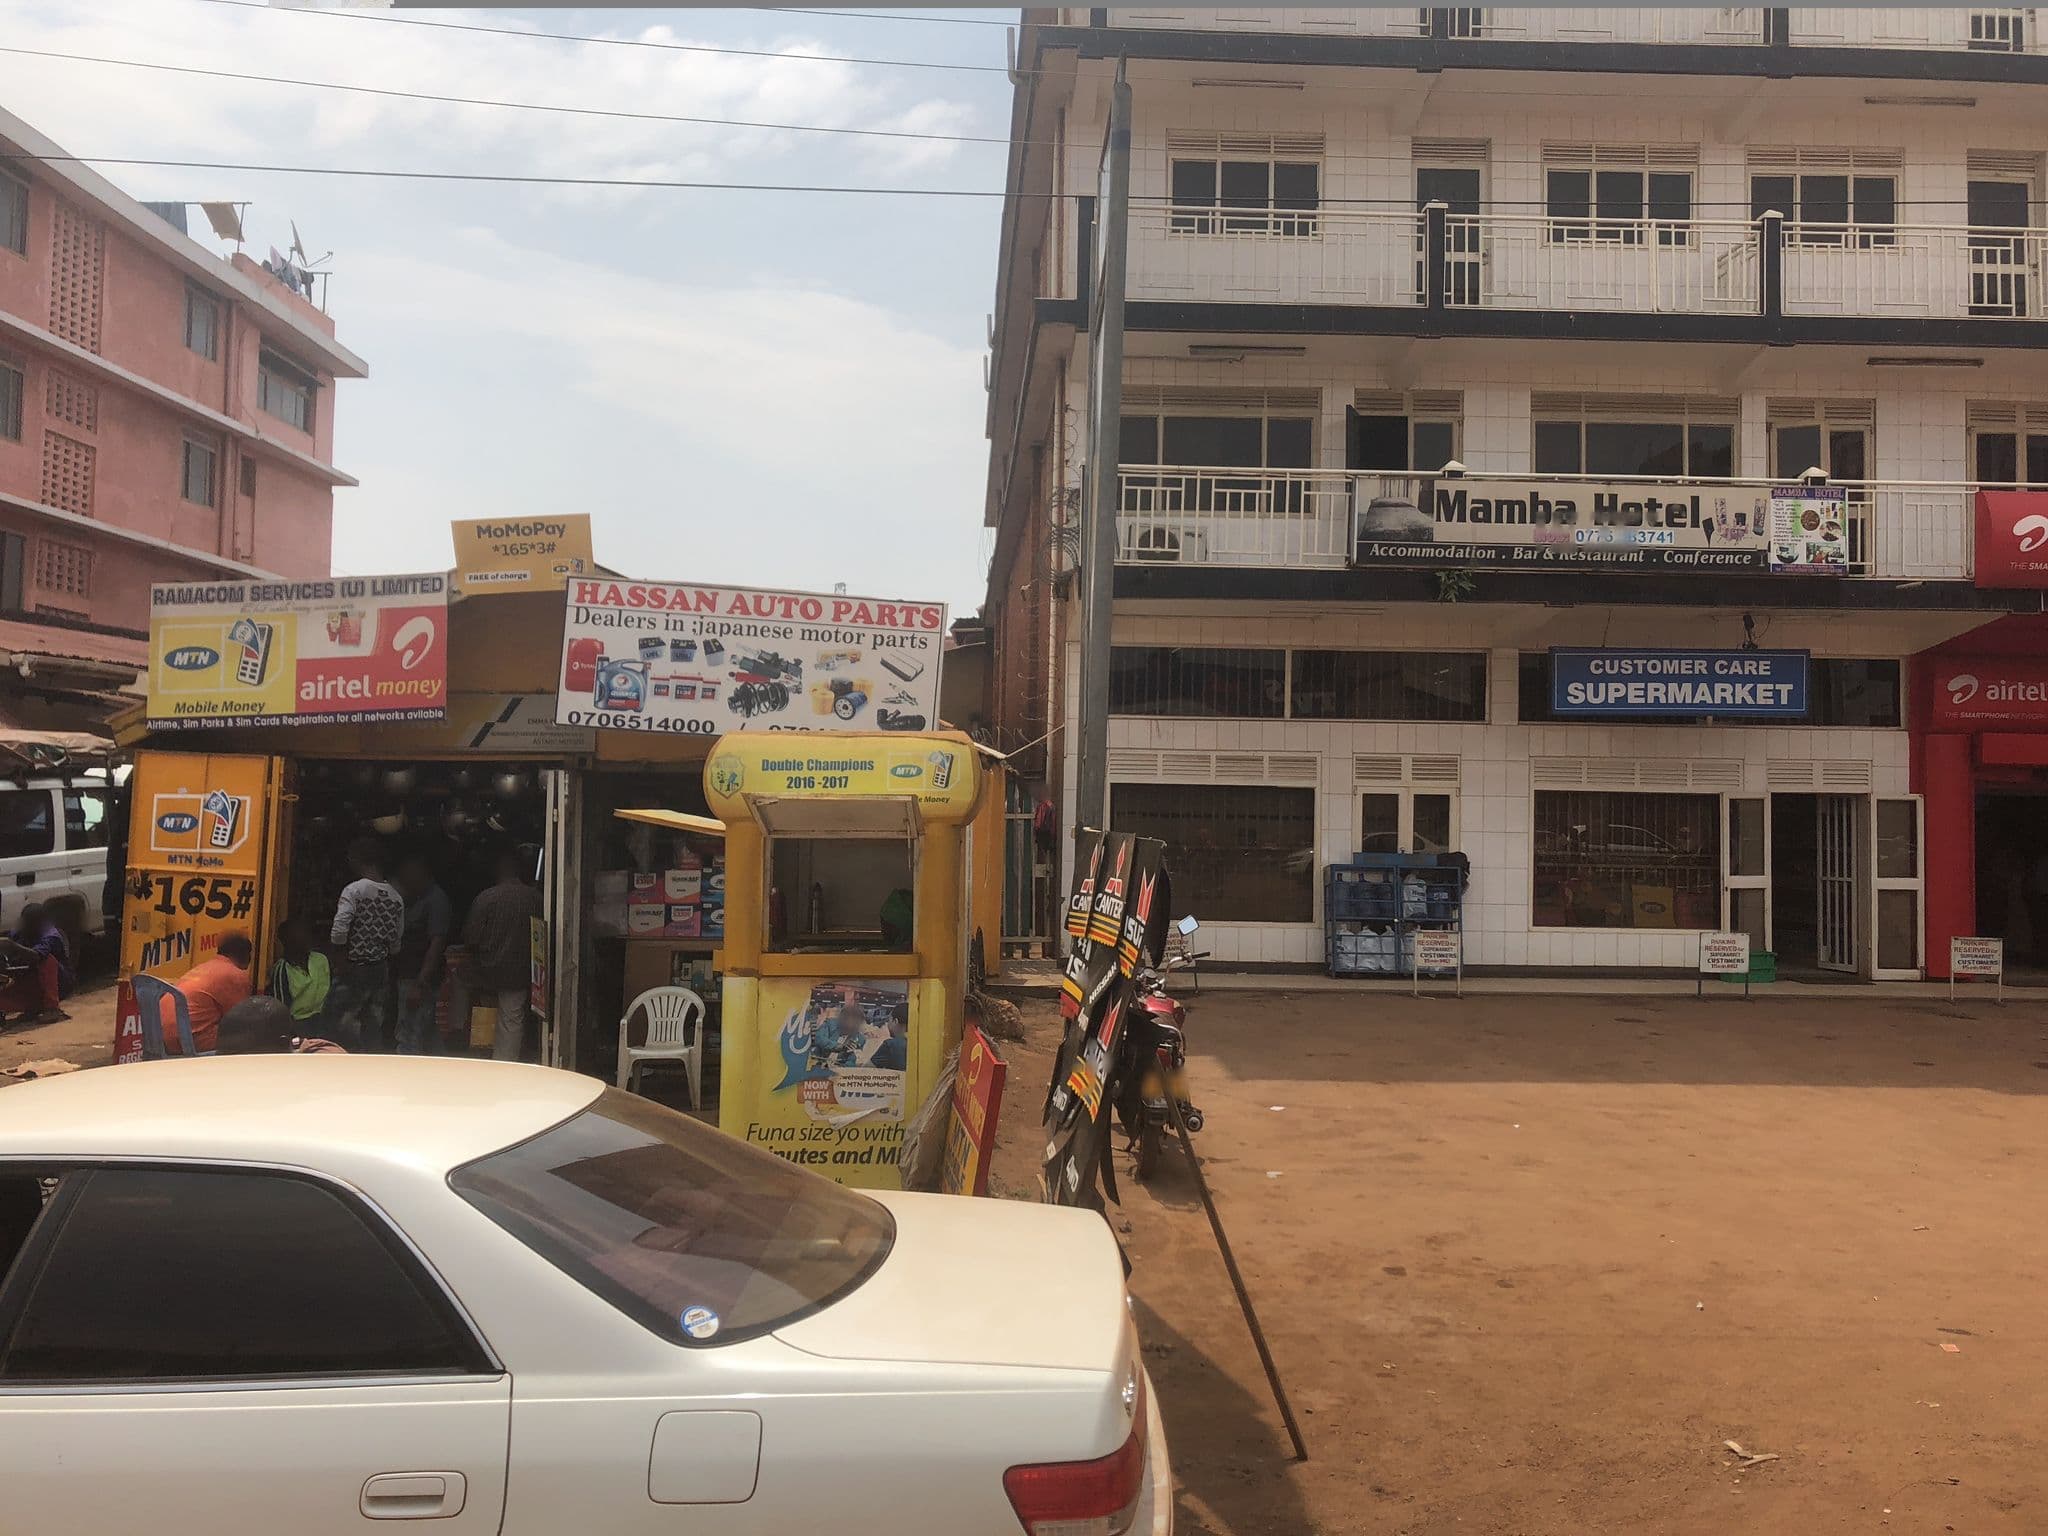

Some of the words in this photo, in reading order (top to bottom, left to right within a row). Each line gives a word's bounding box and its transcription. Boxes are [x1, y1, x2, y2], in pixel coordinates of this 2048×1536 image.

[1435, 489, 1577, 525] Mamba
[1594, 493, 1700, 528] Hotel
[477, 521, 566, 538] MoMoPay
[1369, 543, 1497, 560] Accommodation
[1512, 547, 1538, 560] Bar
[1543, 548, 1554, 560] &
[1663, 550, 1752, 567] Conference
[468, 573, 489, 581] FREE
[153, 585, 246, 606] RAMACOM
[250, 581, 335, 602] SERVICES
[340, 580, 365, 598] (U)
[371, 576, 444, 596] LIMITED
[575, 582, 719, 613] HASSAN
[726, 592, 822, 620] AUTO
[832, 600, 940, 629] PARTS
[574, 606, 657, 630] Dealers
[664, 613, 685, 632] in
[800, 627, 865, 645] motor
[872, 632, 928, 650] parts
[173, 651, 210, 666] MTN
[1589, 659, 1708, 676] CUSTOMER
[1714, 660, 1771, 676] CARE
[300, 674, 372, 700] airtel
[375, 677, 442, 699] money
[1567, 682, 1793, 705] SUPERMARKET
[1986, 680, 2048, 701] airtel
[174, 700, 218, 714] Mobile
[221, 700, 266, 716] Money
[1960, 711, 2010, 719] SMARTPHONE
[146, 718, 180, 731] Airtime,
[183, 718, 199, 729] Sim
[227, 718, 234, 727] &
[235, 717, 251, 727] Sim
[254, 716, 280, 727] Cards
[282, 713, 334, 727] Registration
[336, 713, 348, 723] for
[351, 712, 362, 722] all
[364, 711, 404, 722] networks
[567, 710, 715, 734] 0706514000
[761, 758, 804, 772] Double
[806, 758, 874, 773] Champions
[895, 766, 918, 776] MTN
[786, 775, 815, 789] 2016
[924, 795, 950, 804] Money
[163, 816, 192, 829] MTN
[168, 854, 193, 864] MTN
[140, 927, 192, 971] MTN
[804, 1080, 830, 1090] NOW
[803, 1090, 829, 1100] WITH
[746, 1122, 795, 1142] Funa
[798, 1123, 834, 1142] size
[836, 1126, 859, 1146] yo
[864, 1124, 906, 1142] with
[832, 1145, 872, 1165] and
